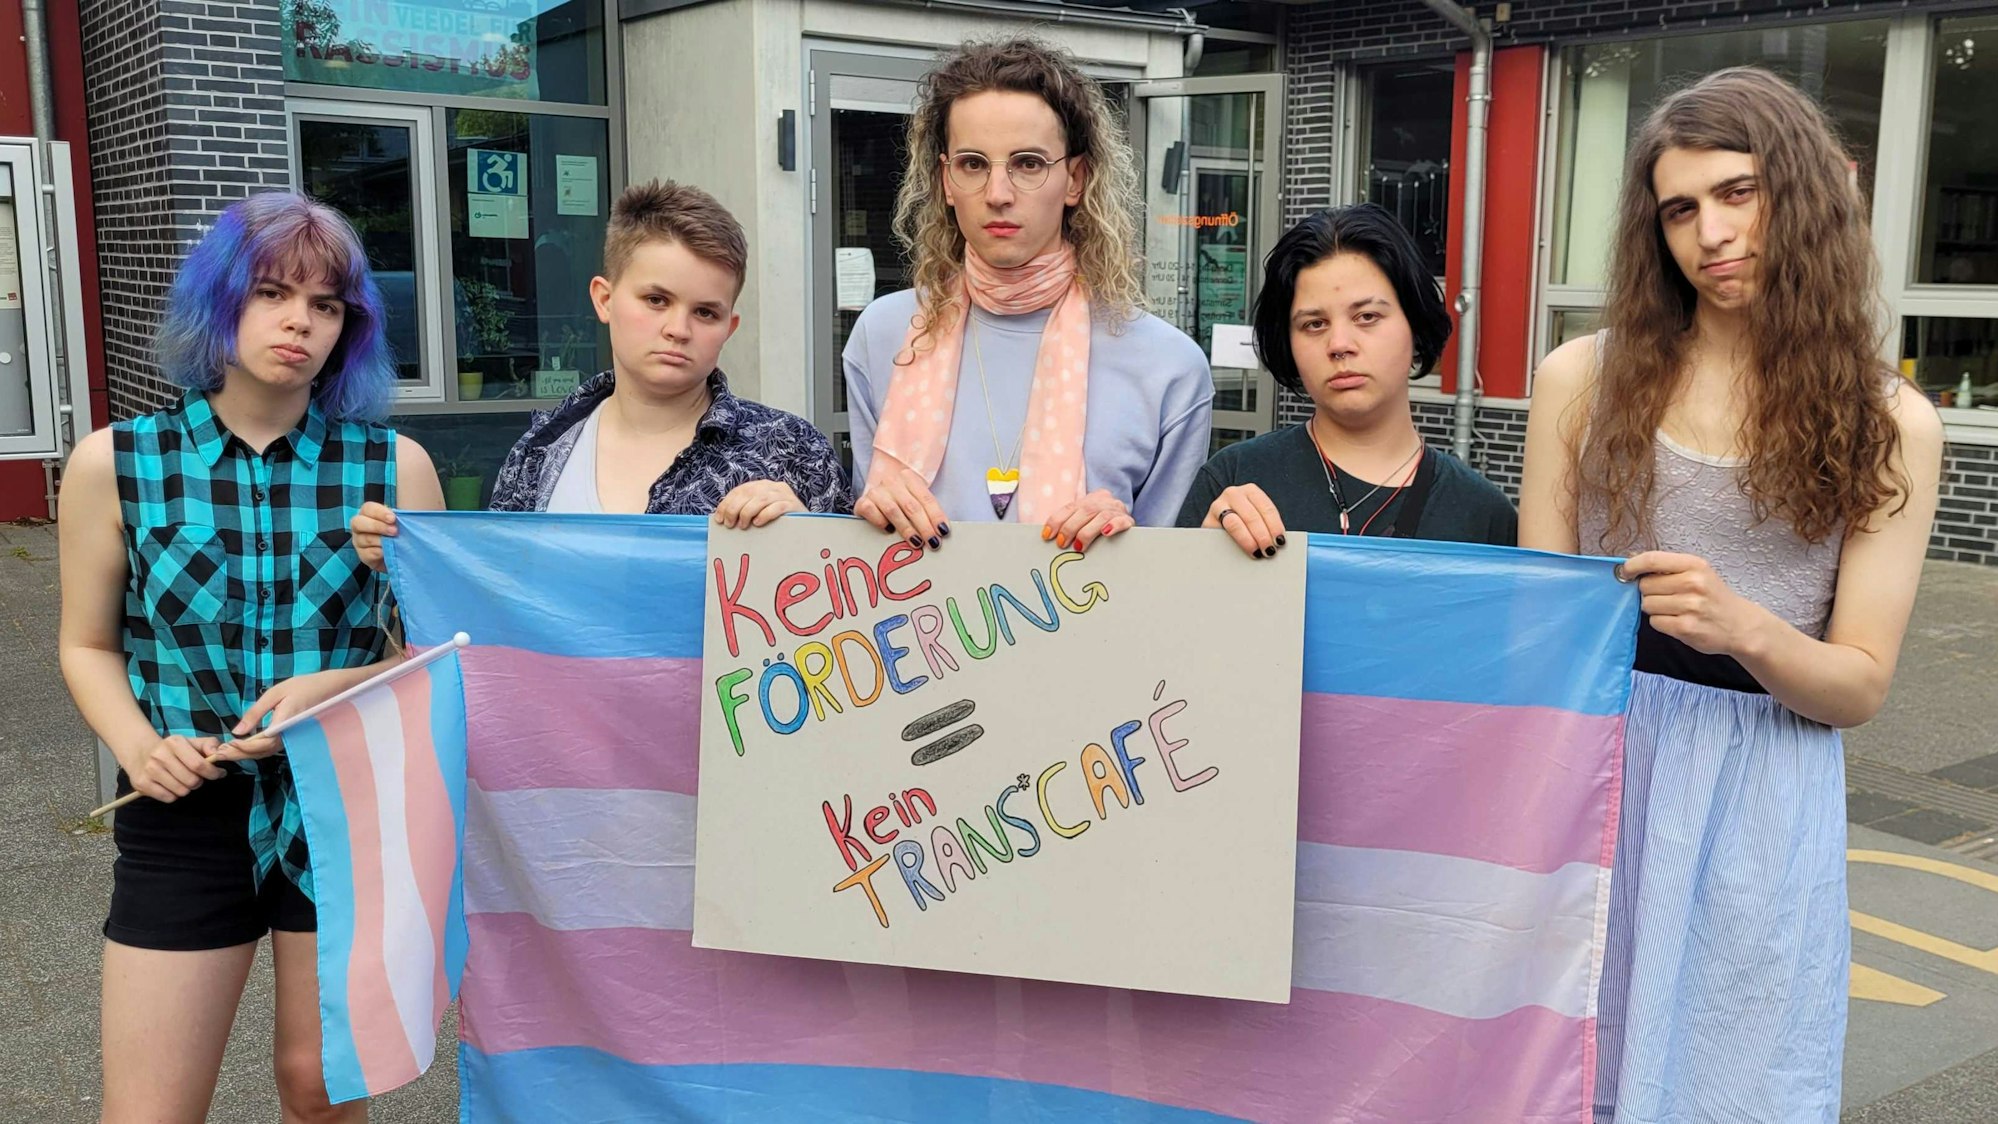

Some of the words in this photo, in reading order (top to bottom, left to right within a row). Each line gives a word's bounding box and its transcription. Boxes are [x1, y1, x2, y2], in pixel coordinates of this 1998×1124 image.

[295, 22, 531, 81] RASSISMUS
[395, 5, 482, 36] VEEDEL
[713, 540, 932, 658] Keine
[715, 551, 1110, 757] FÖRDERUNG
[821, 786, 938, 872] Kein
